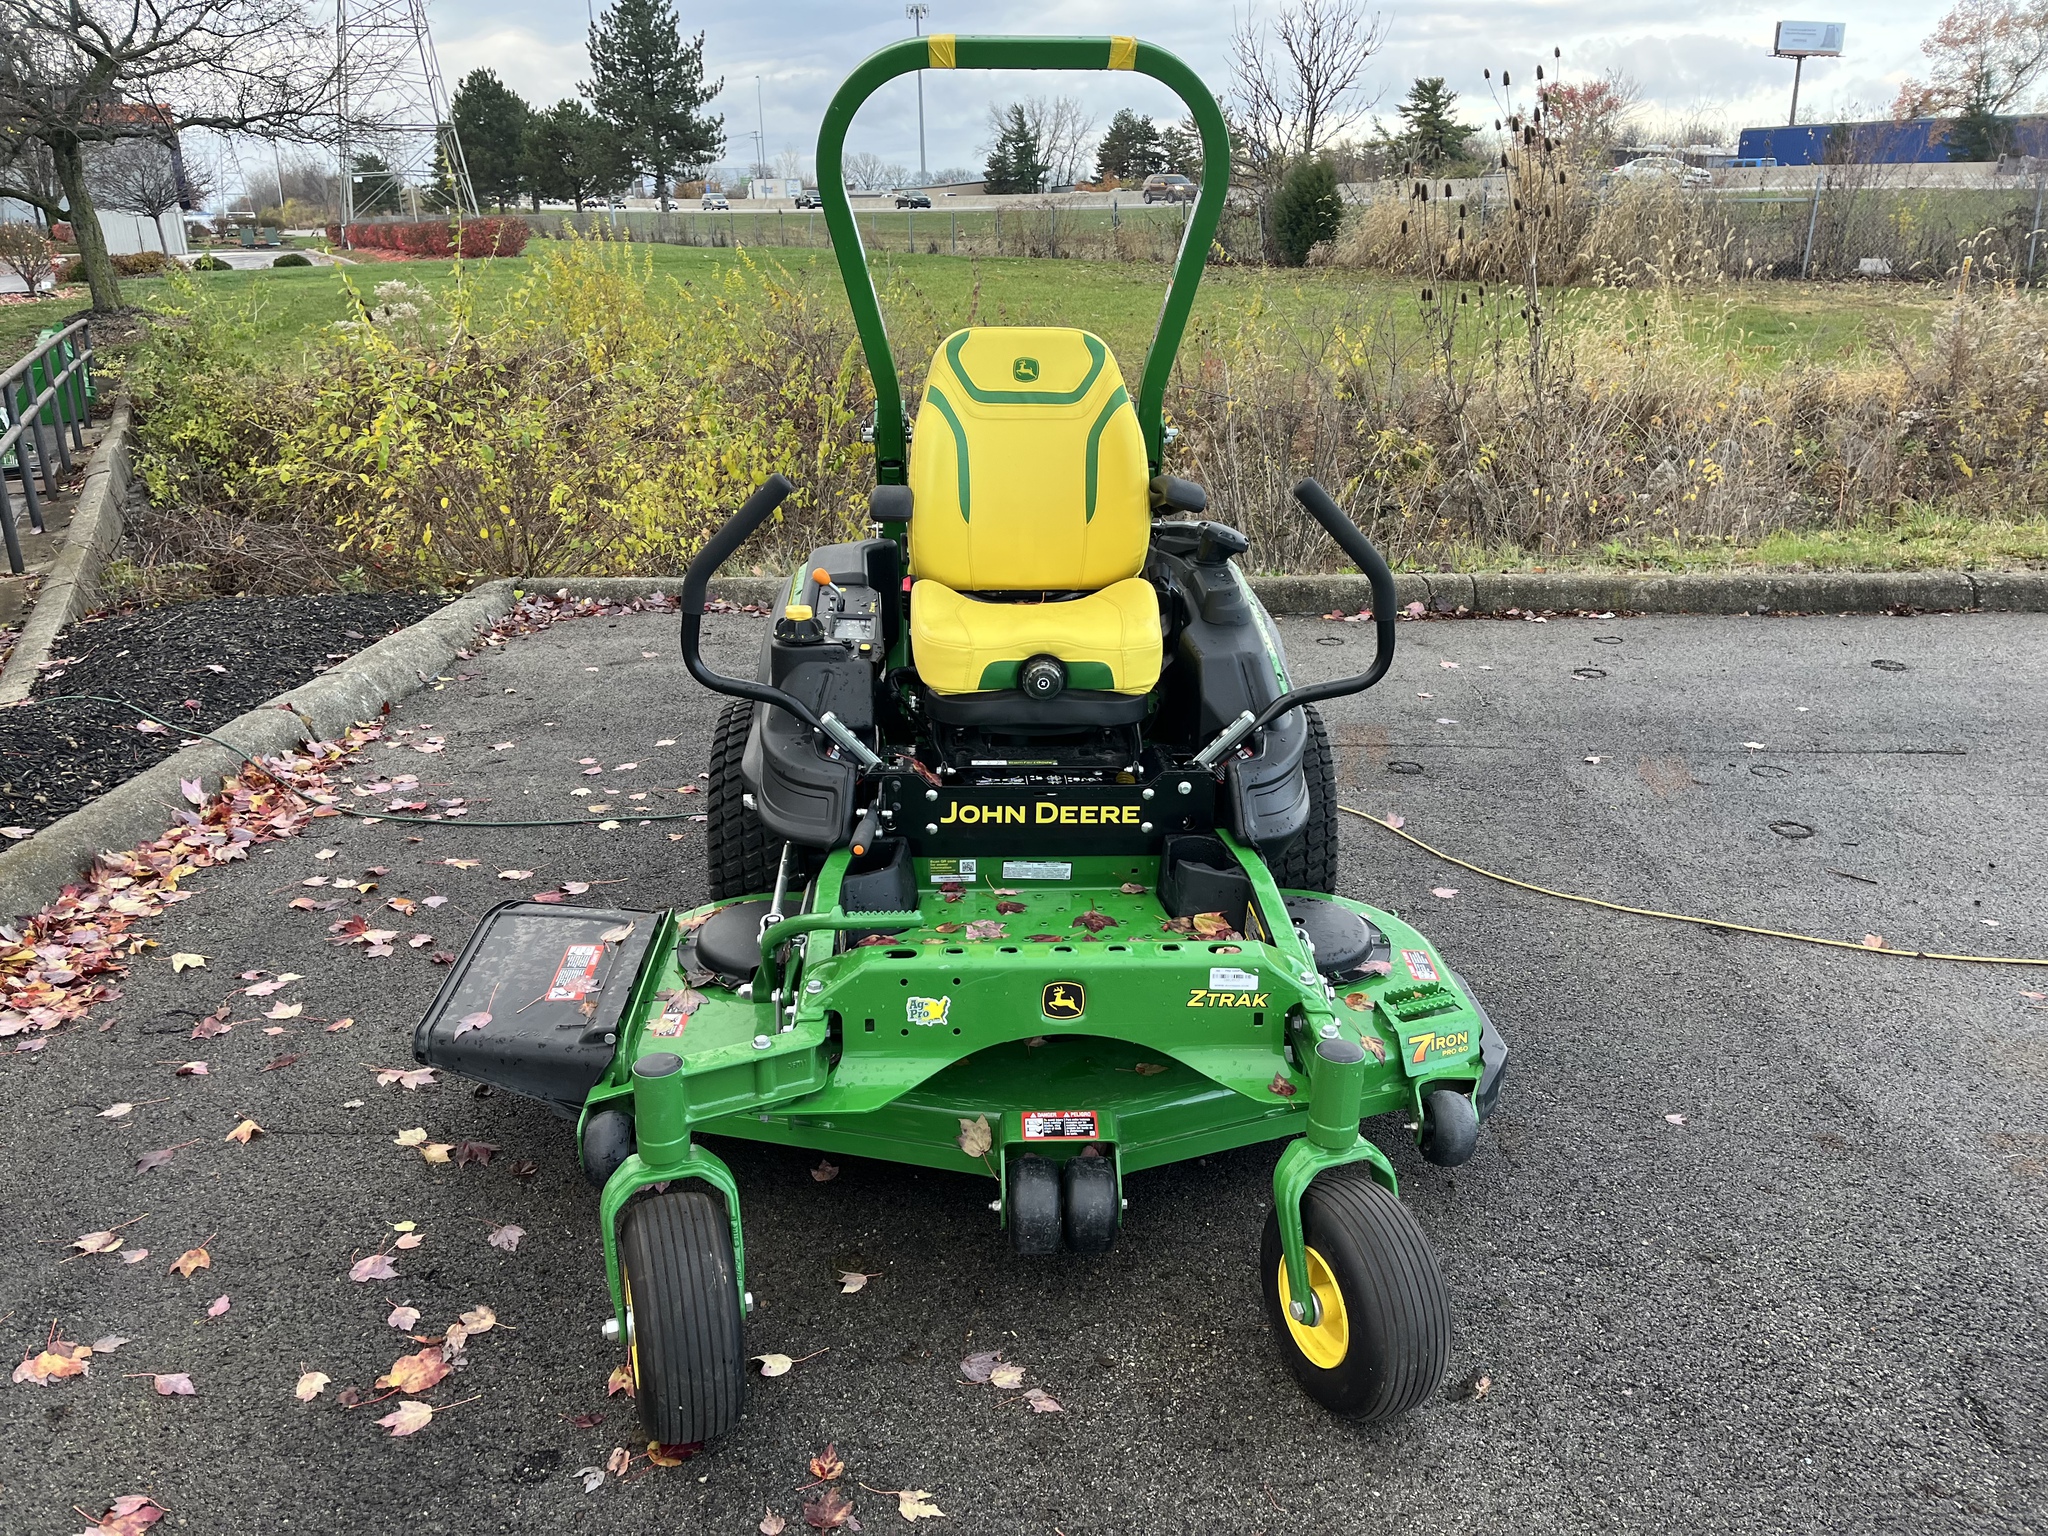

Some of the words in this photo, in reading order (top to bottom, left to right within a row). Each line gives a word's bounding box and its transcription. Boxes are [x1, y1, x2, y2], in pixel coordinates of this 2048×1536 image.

[940, 801, 1026, 824] JOHN
[1035, 802, 1141, 824] DEERE
[1186, 989, 1271, 1008] ZTRAK
[910, 1000, 928, 1010] Ag-
[910, 1010, 929, 1018] Pro
[1442, 1048, 1457, 1056] PRO
